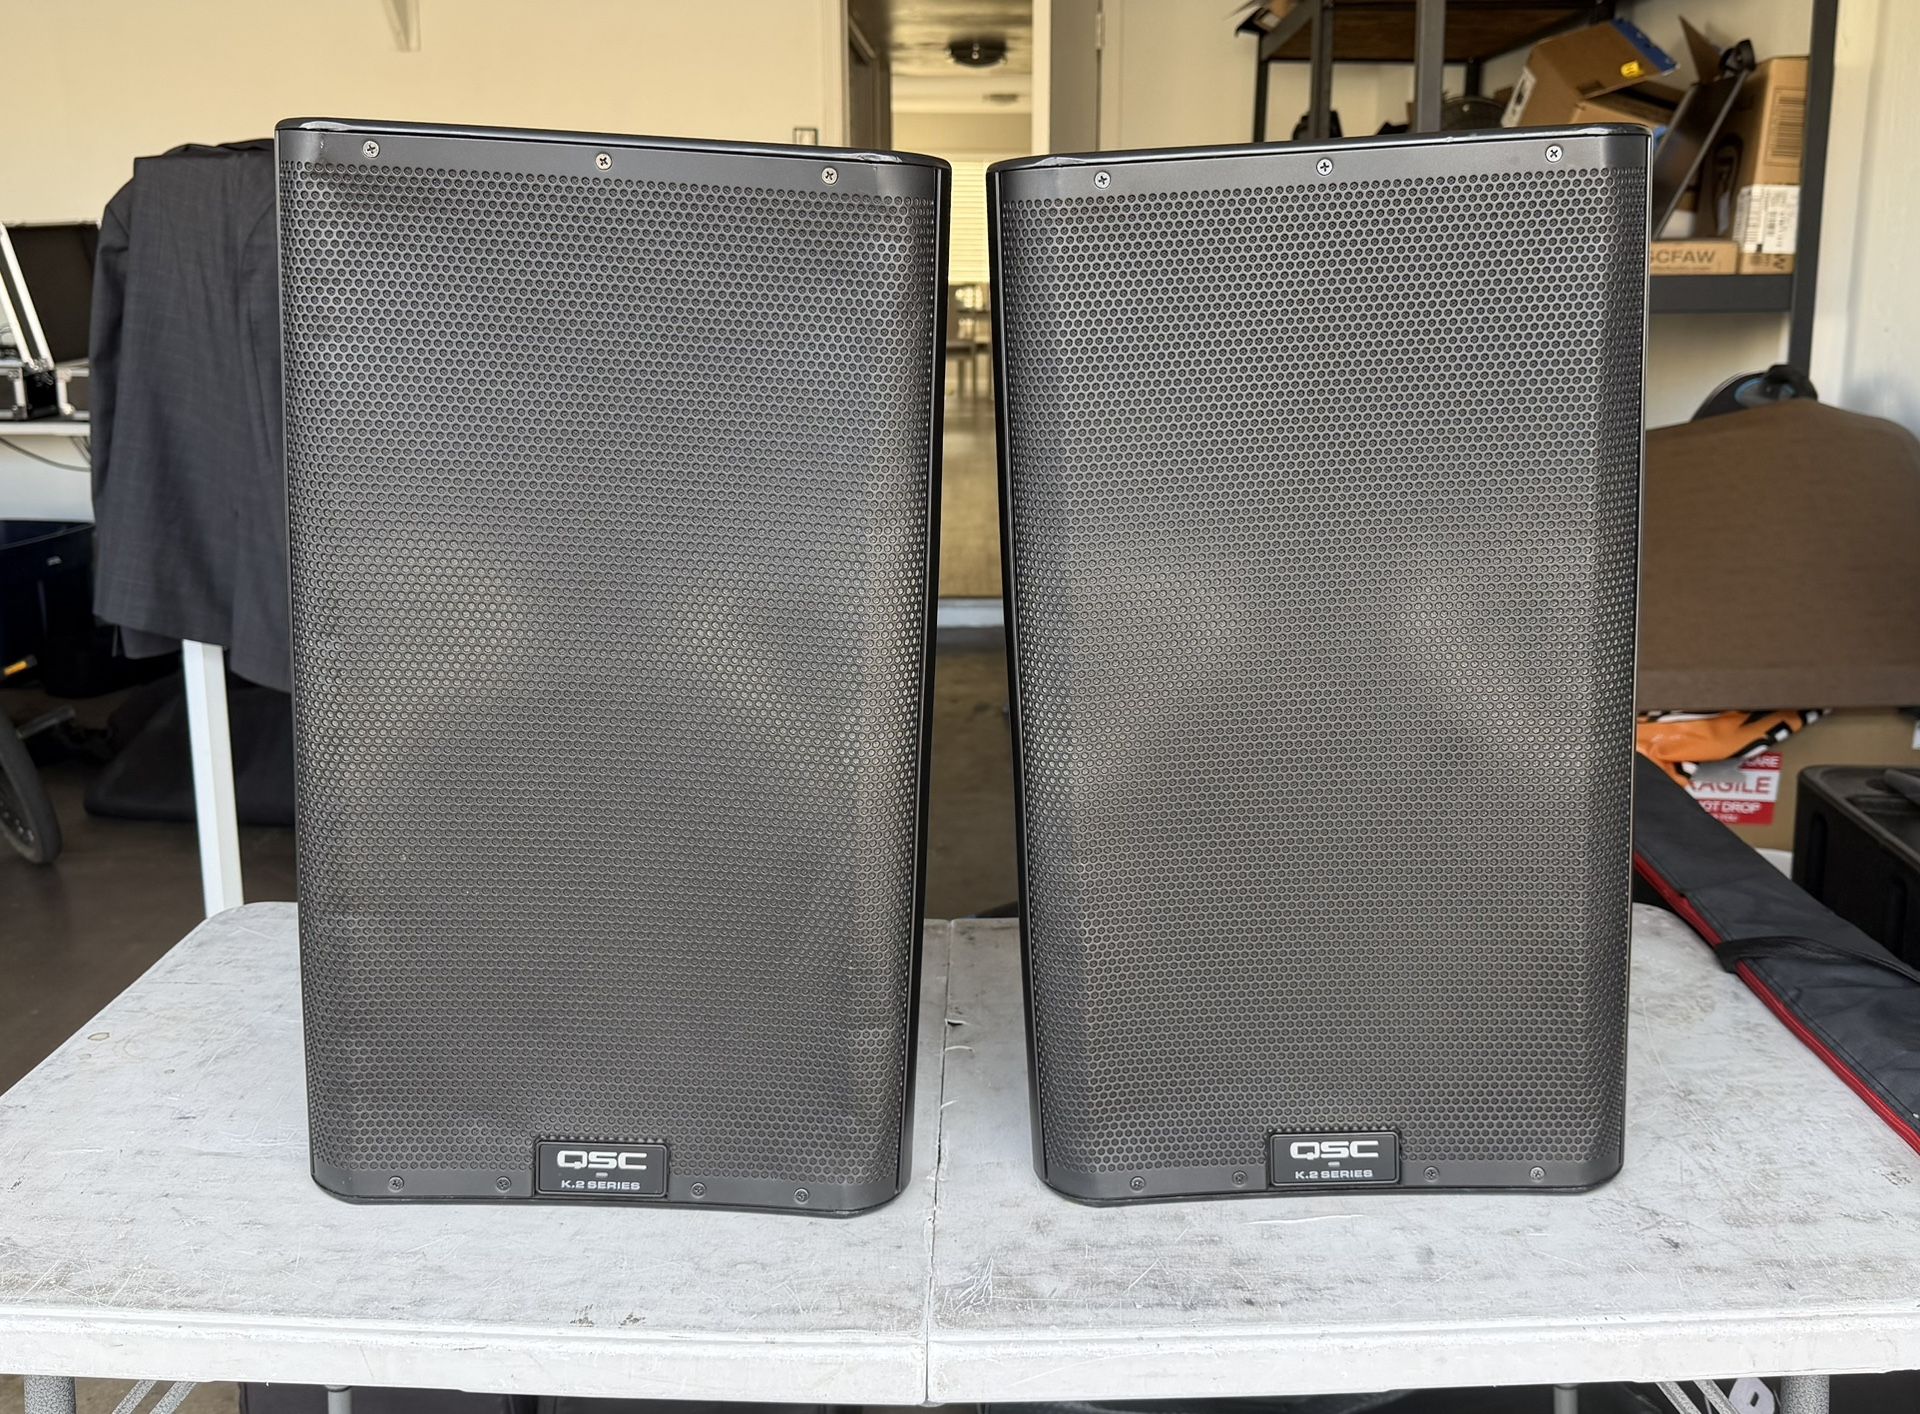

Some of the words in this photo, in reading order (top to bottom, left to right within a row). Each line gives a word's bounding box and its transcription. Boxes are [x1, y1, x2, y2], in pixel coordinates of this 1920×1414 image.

[1721, 801, 1762, 814] DROP
[1289, 1140, 1379, 1160] QSC
[557, 1150, 647, 1170] QSC
[1295, 1170, 1318, 1179] K.2
[1321, 1169, 1373, 1178] SERIES
[561, 1180, 585, 1189] K.2
[587, 1181, 641, 1190] SERIES
